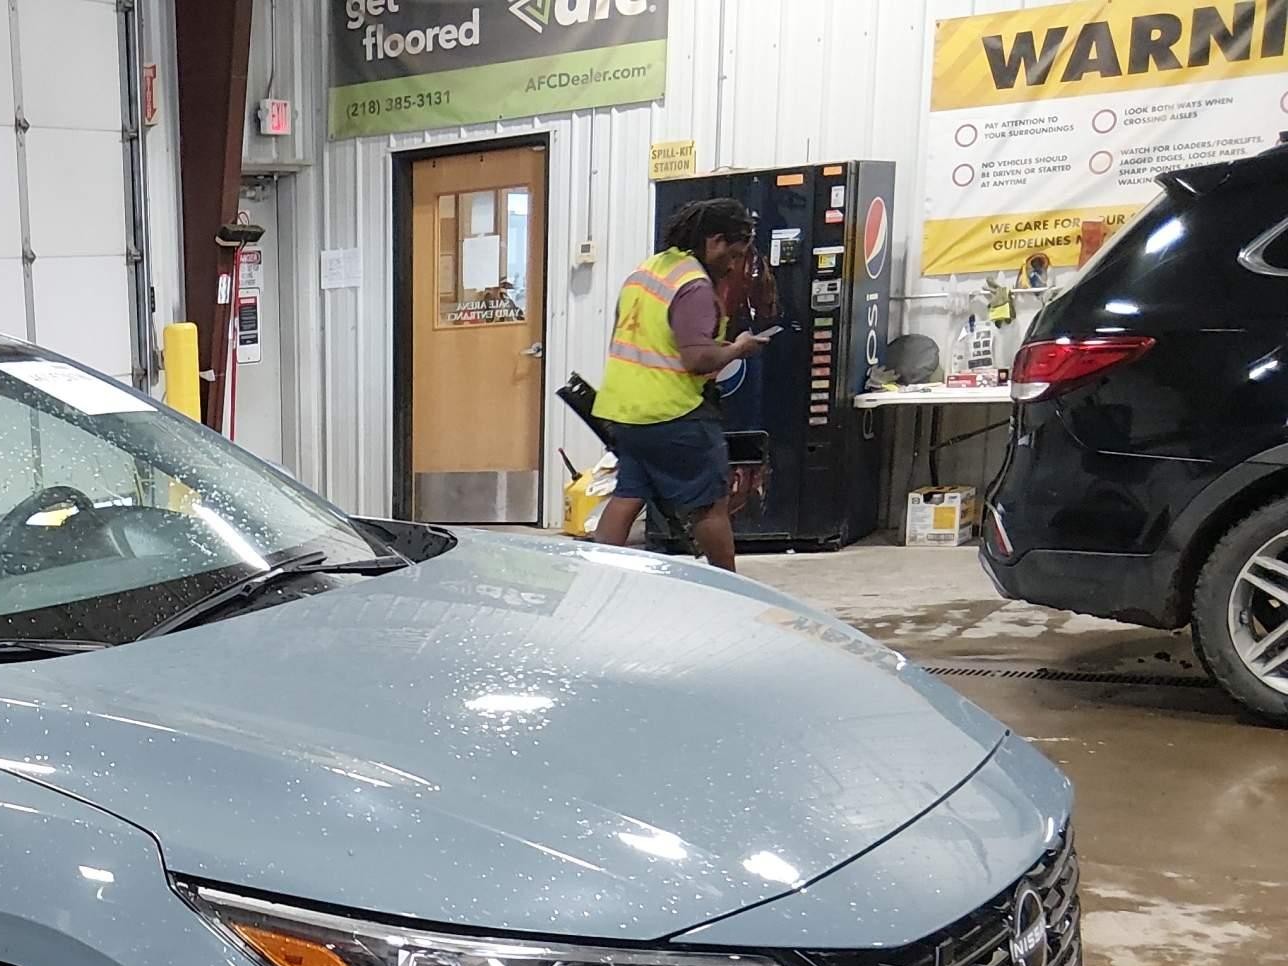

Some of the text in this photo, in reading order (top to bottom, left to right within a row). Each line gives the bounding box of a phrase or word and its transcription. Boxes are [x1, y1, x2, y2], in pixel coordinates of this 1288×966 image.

[363, 8, 480, 61] floored
[525, 64, 647, 93] AFCDealer.com
[346, 90, 452, 121] (218) 385-3131
[1125, 97, 1234, 116] LOOK BOTH WAYS WHEN
[272, 102, 288, 130] EXIT
[1002, 118, 1045, 128] ATTENTION
[1123, 111, 1198, 126] CROSSING AISLES
[1009, 124, 1075, 137] SURROUNDINGS
[652, 146, 693, 160] SPILL-KIT
[1120, 146, 1151, 156] WATCH
[1152, 144, 1170, 153] FOR
[981, 155, 1068, 169] NO VEHICLES SHOULD
[1120, 156, 1154, 166] JAGGED
[1188, 150, 1217, 160] LOOSE
[654, 160, 690, 173] STATION
[981, 164, 1072, 179] BE DRIVEN OR STARTED
[1119, 167, 1147, 177] SHARP
[980, 178, 1027, 189] AT ANYTIME
[990, 223, 1011, 234] WE
[1014, 219, 1049, 232] CARE
[1054, 217, 1081, 229] FOR
[993, 234, 1071, 251] GUIDELINES
[862, 292, 880, 440] ppsi
